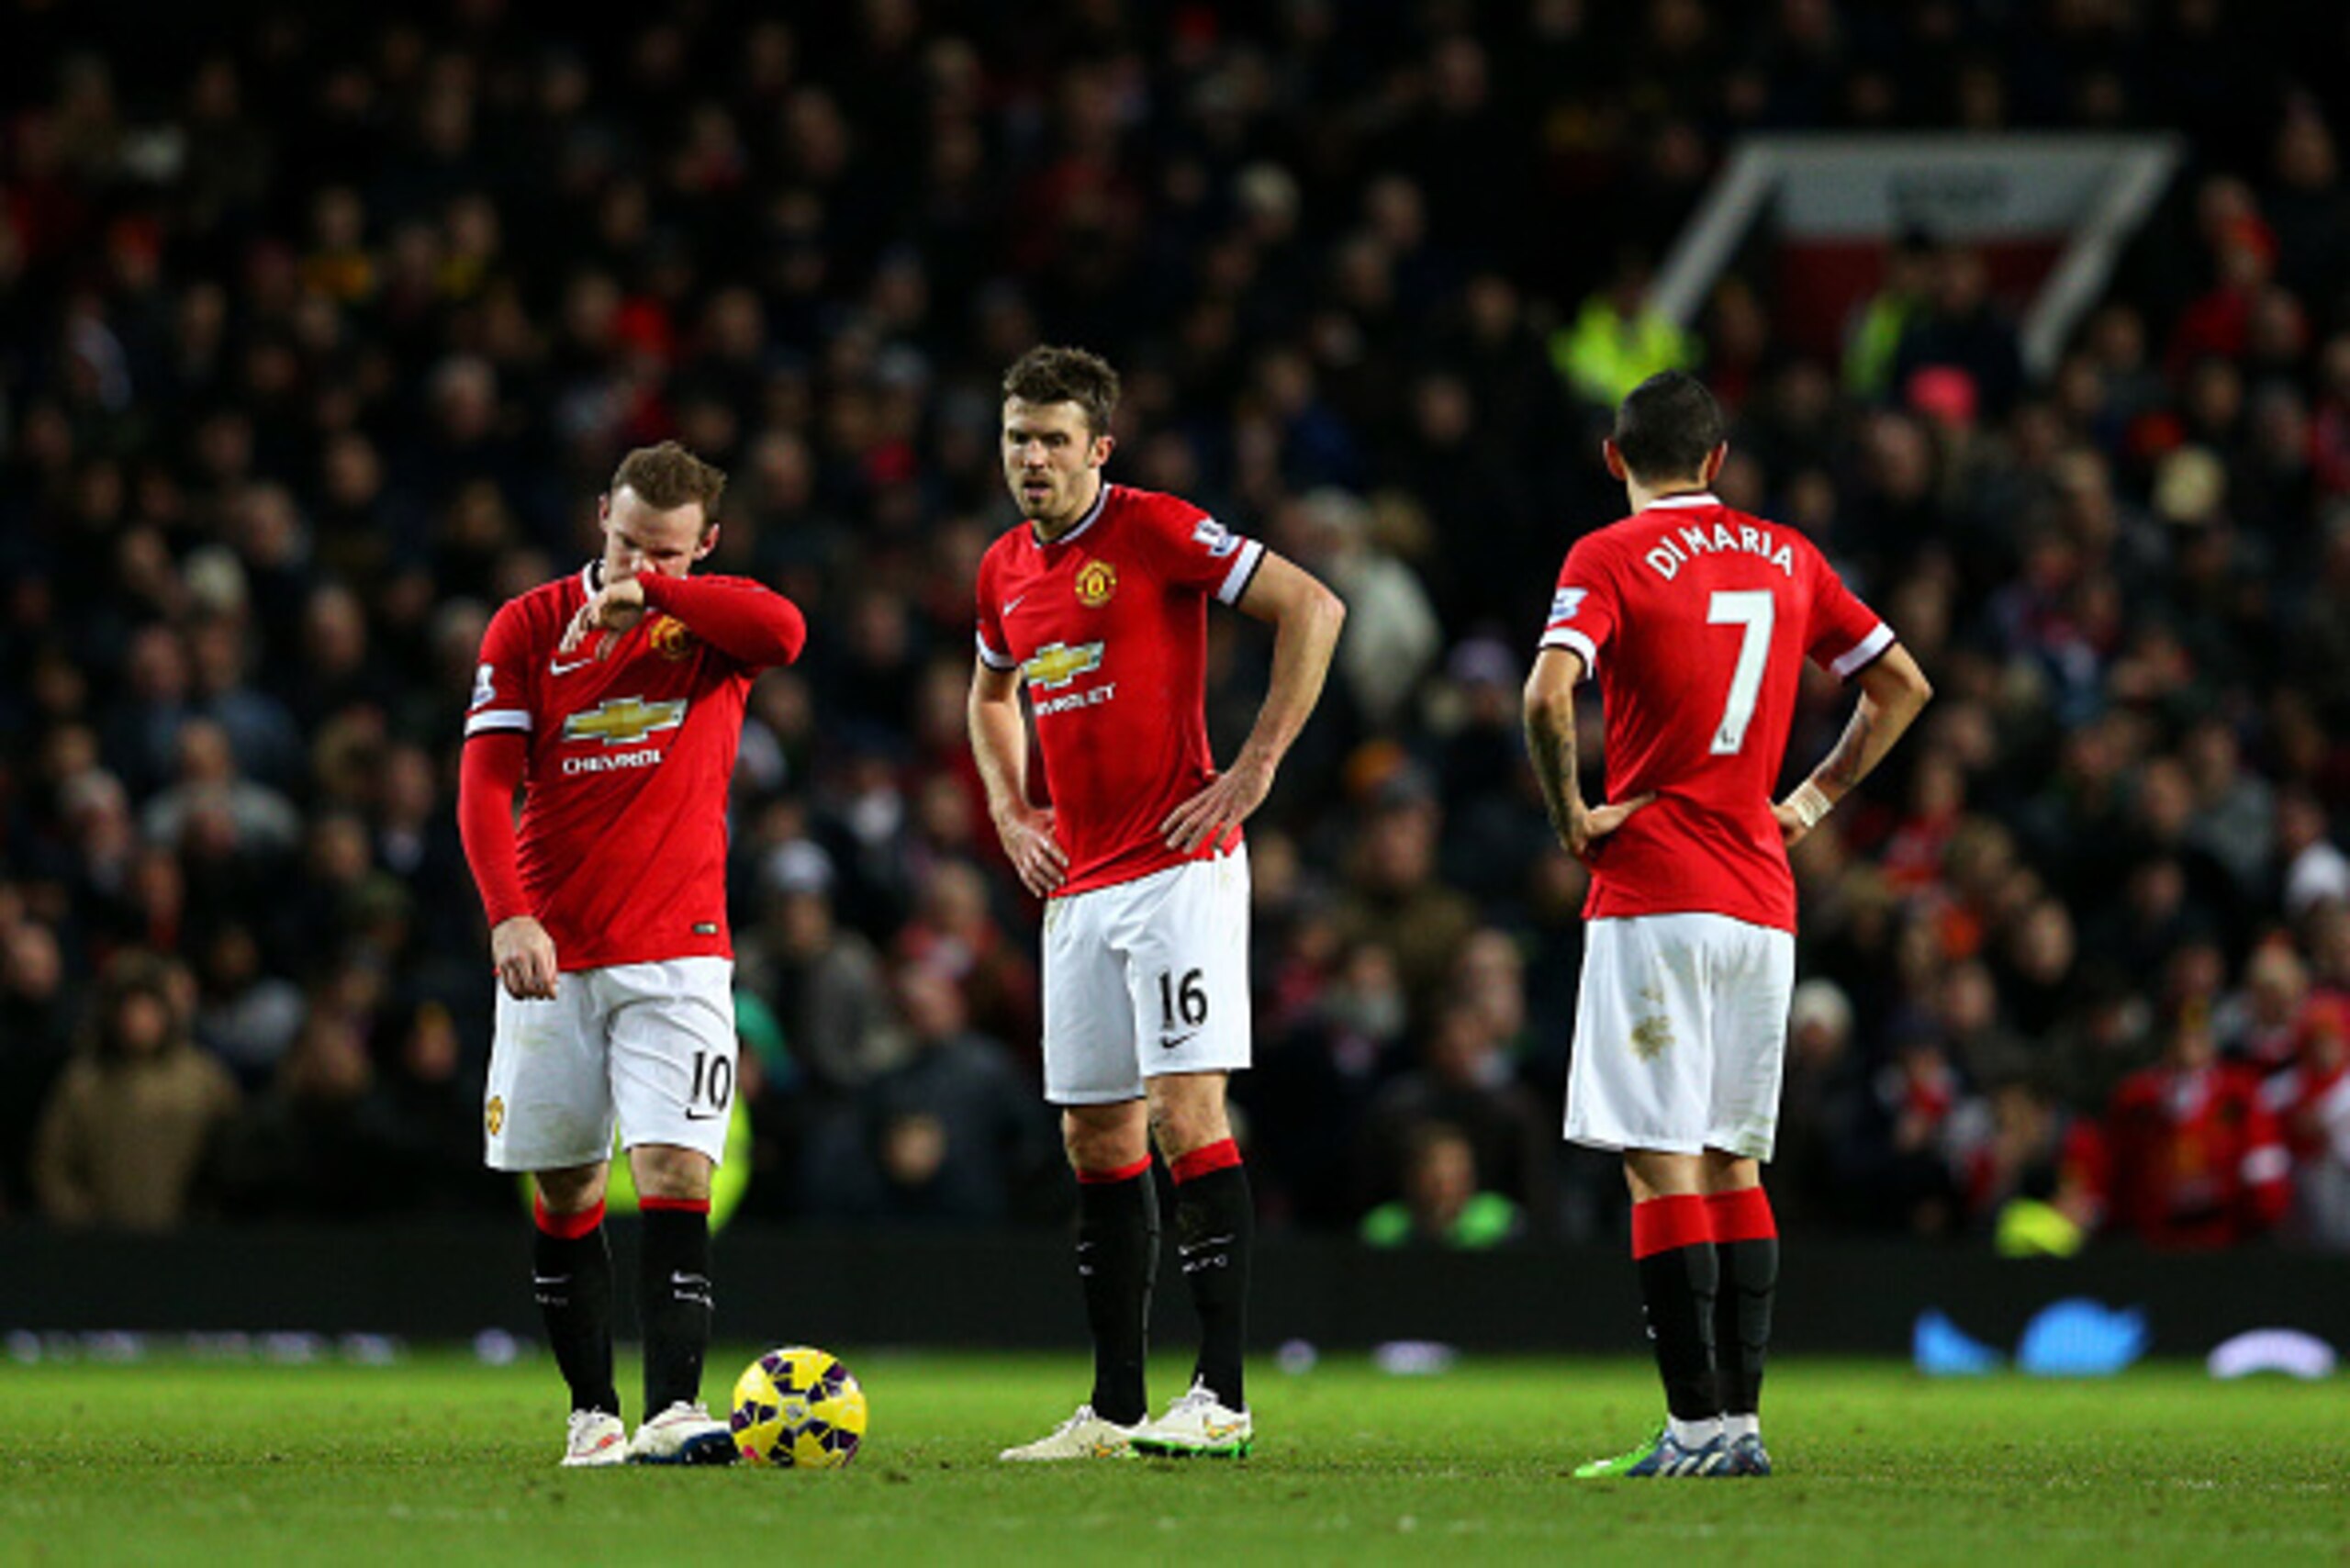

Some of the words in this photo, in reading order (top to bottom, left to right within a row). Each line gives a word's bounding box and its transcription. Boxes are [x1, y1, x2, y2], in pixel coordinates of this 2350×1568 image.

[1645, 535, 1688, 580] DI
[1677, 523, 1793, 577] MARIA
[1707, 588, 1775, 755] 7
[563, 749, 664, 775] CHEVROL
[1159, 966, 1208, 1031] 16
[691, 1050, 731, 1113] 10
